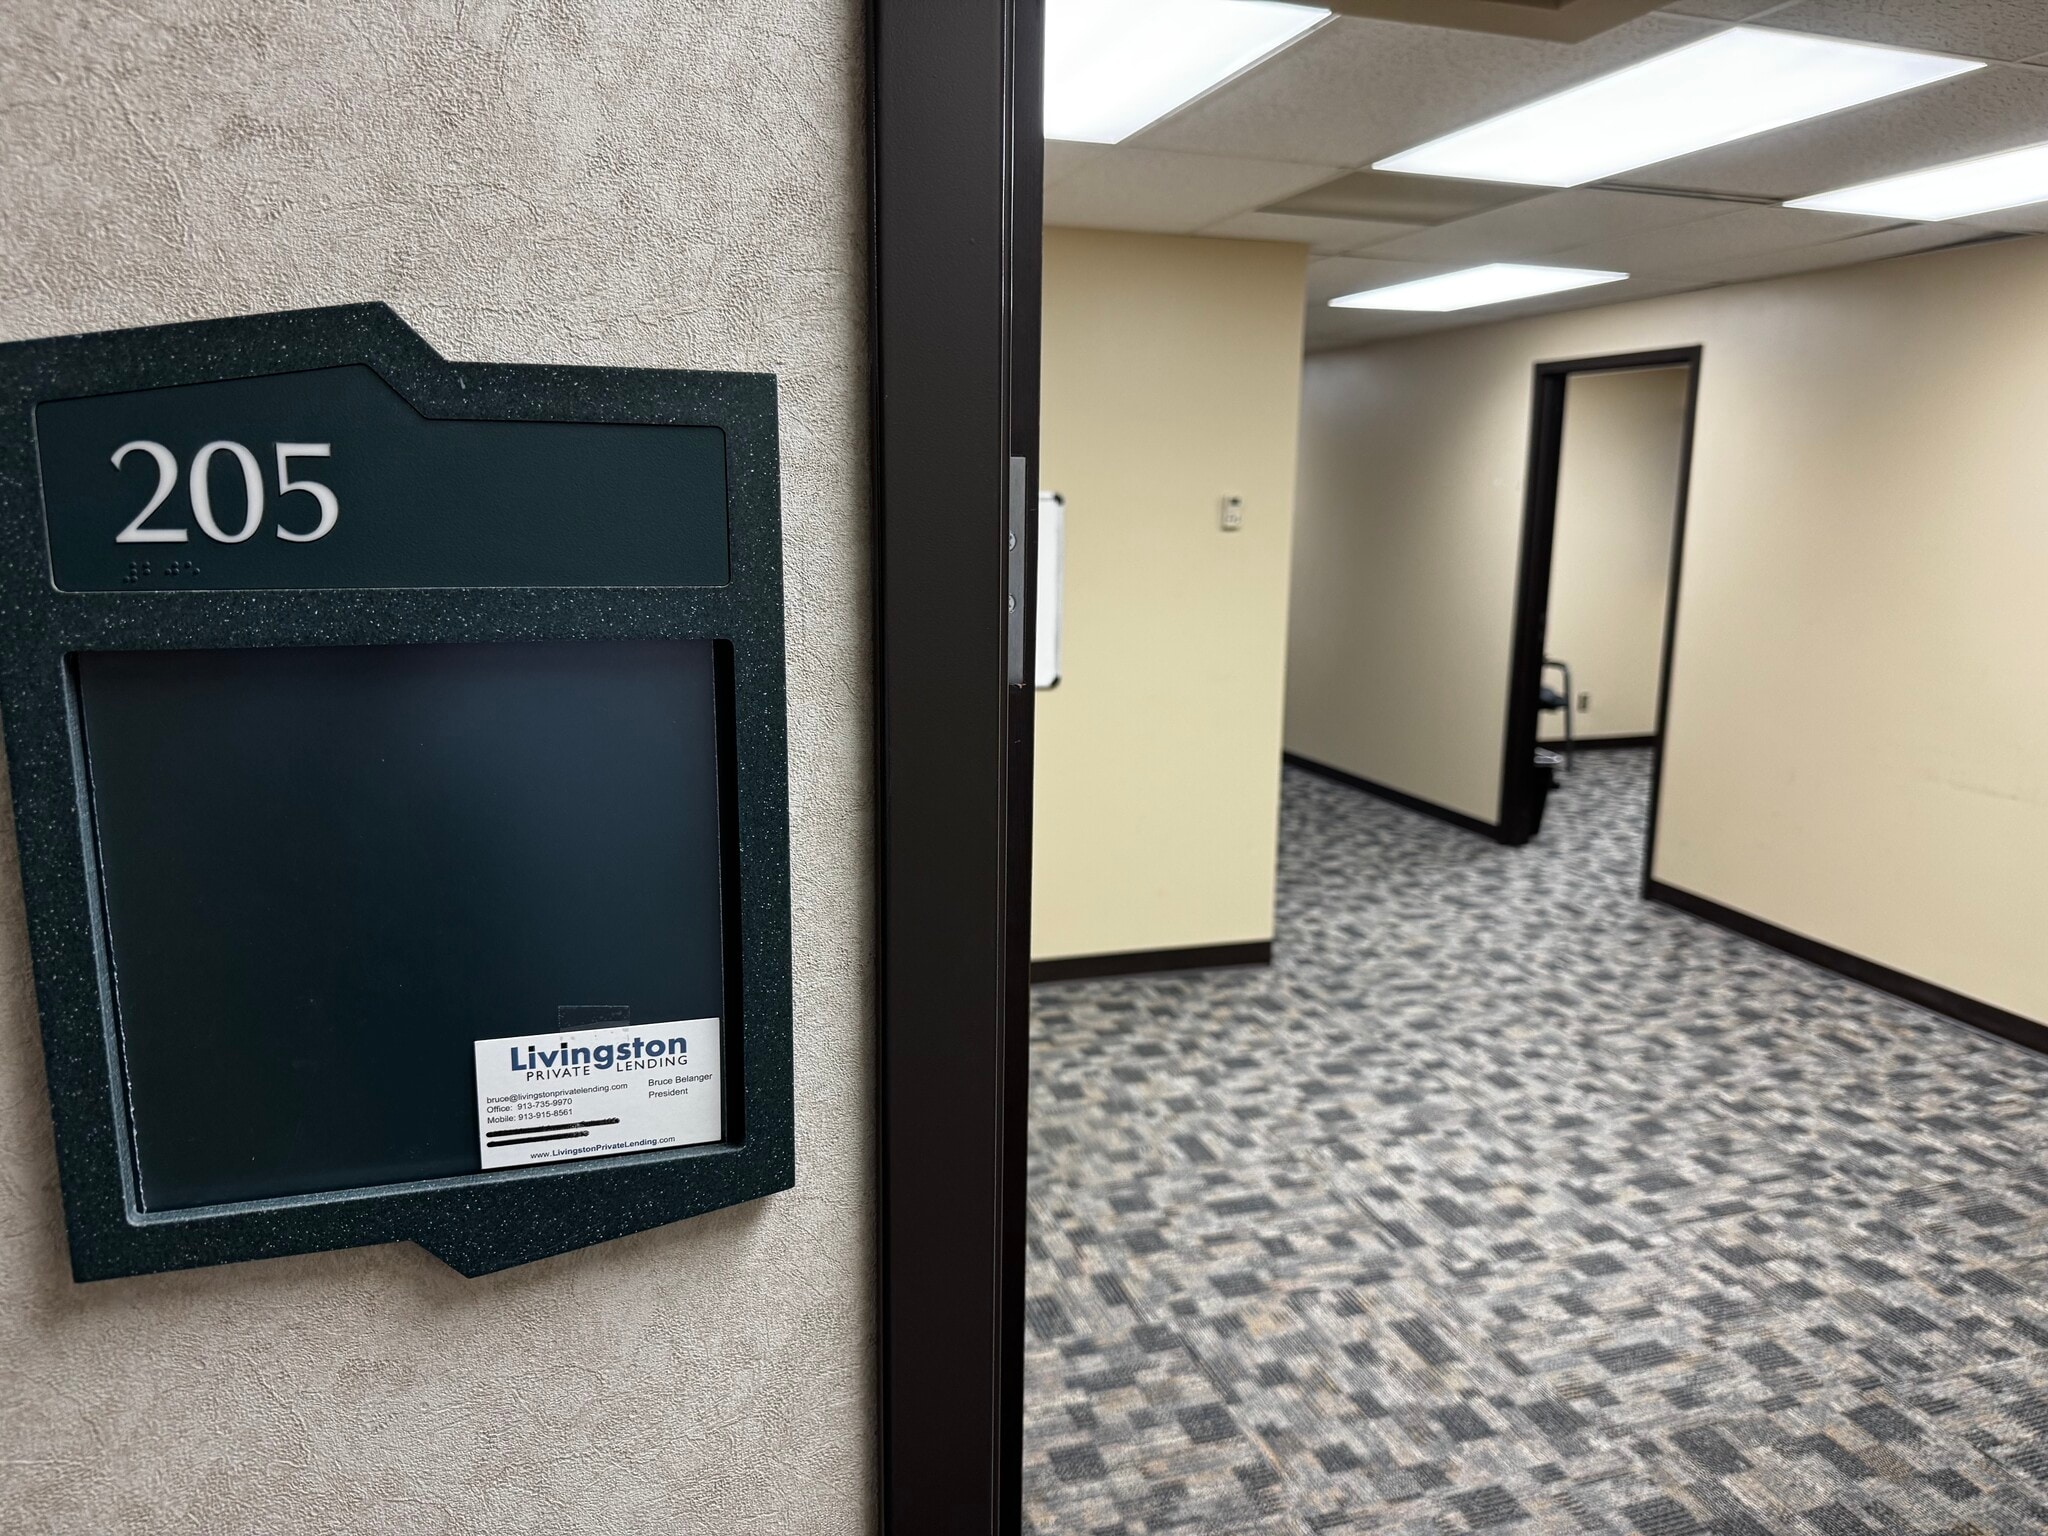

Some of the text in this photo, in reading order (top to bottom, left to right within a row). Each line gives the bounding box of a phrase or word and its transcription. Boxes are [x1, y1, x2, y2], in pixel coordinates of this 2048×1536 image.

[110, 440, 339, 543] 205
[511, 1037, 687, 1071] Livingston
[526, 1055, 688, 1081] PRIVATE LENDING
[648, 1073, 713, 1087] Bruce Belanger
[486, 1082, 628, 1104] bruce@livingstonprivatelending.com
[648, 1087, 689, 1099] President
[486, 1097, 573, 1114] Office: 913-735-9970
[487, 1108, 573, 1124] Mobile: 913-915-8561
[530, 1136, 676, 1159] www.LivingstonPrivateLending.com
